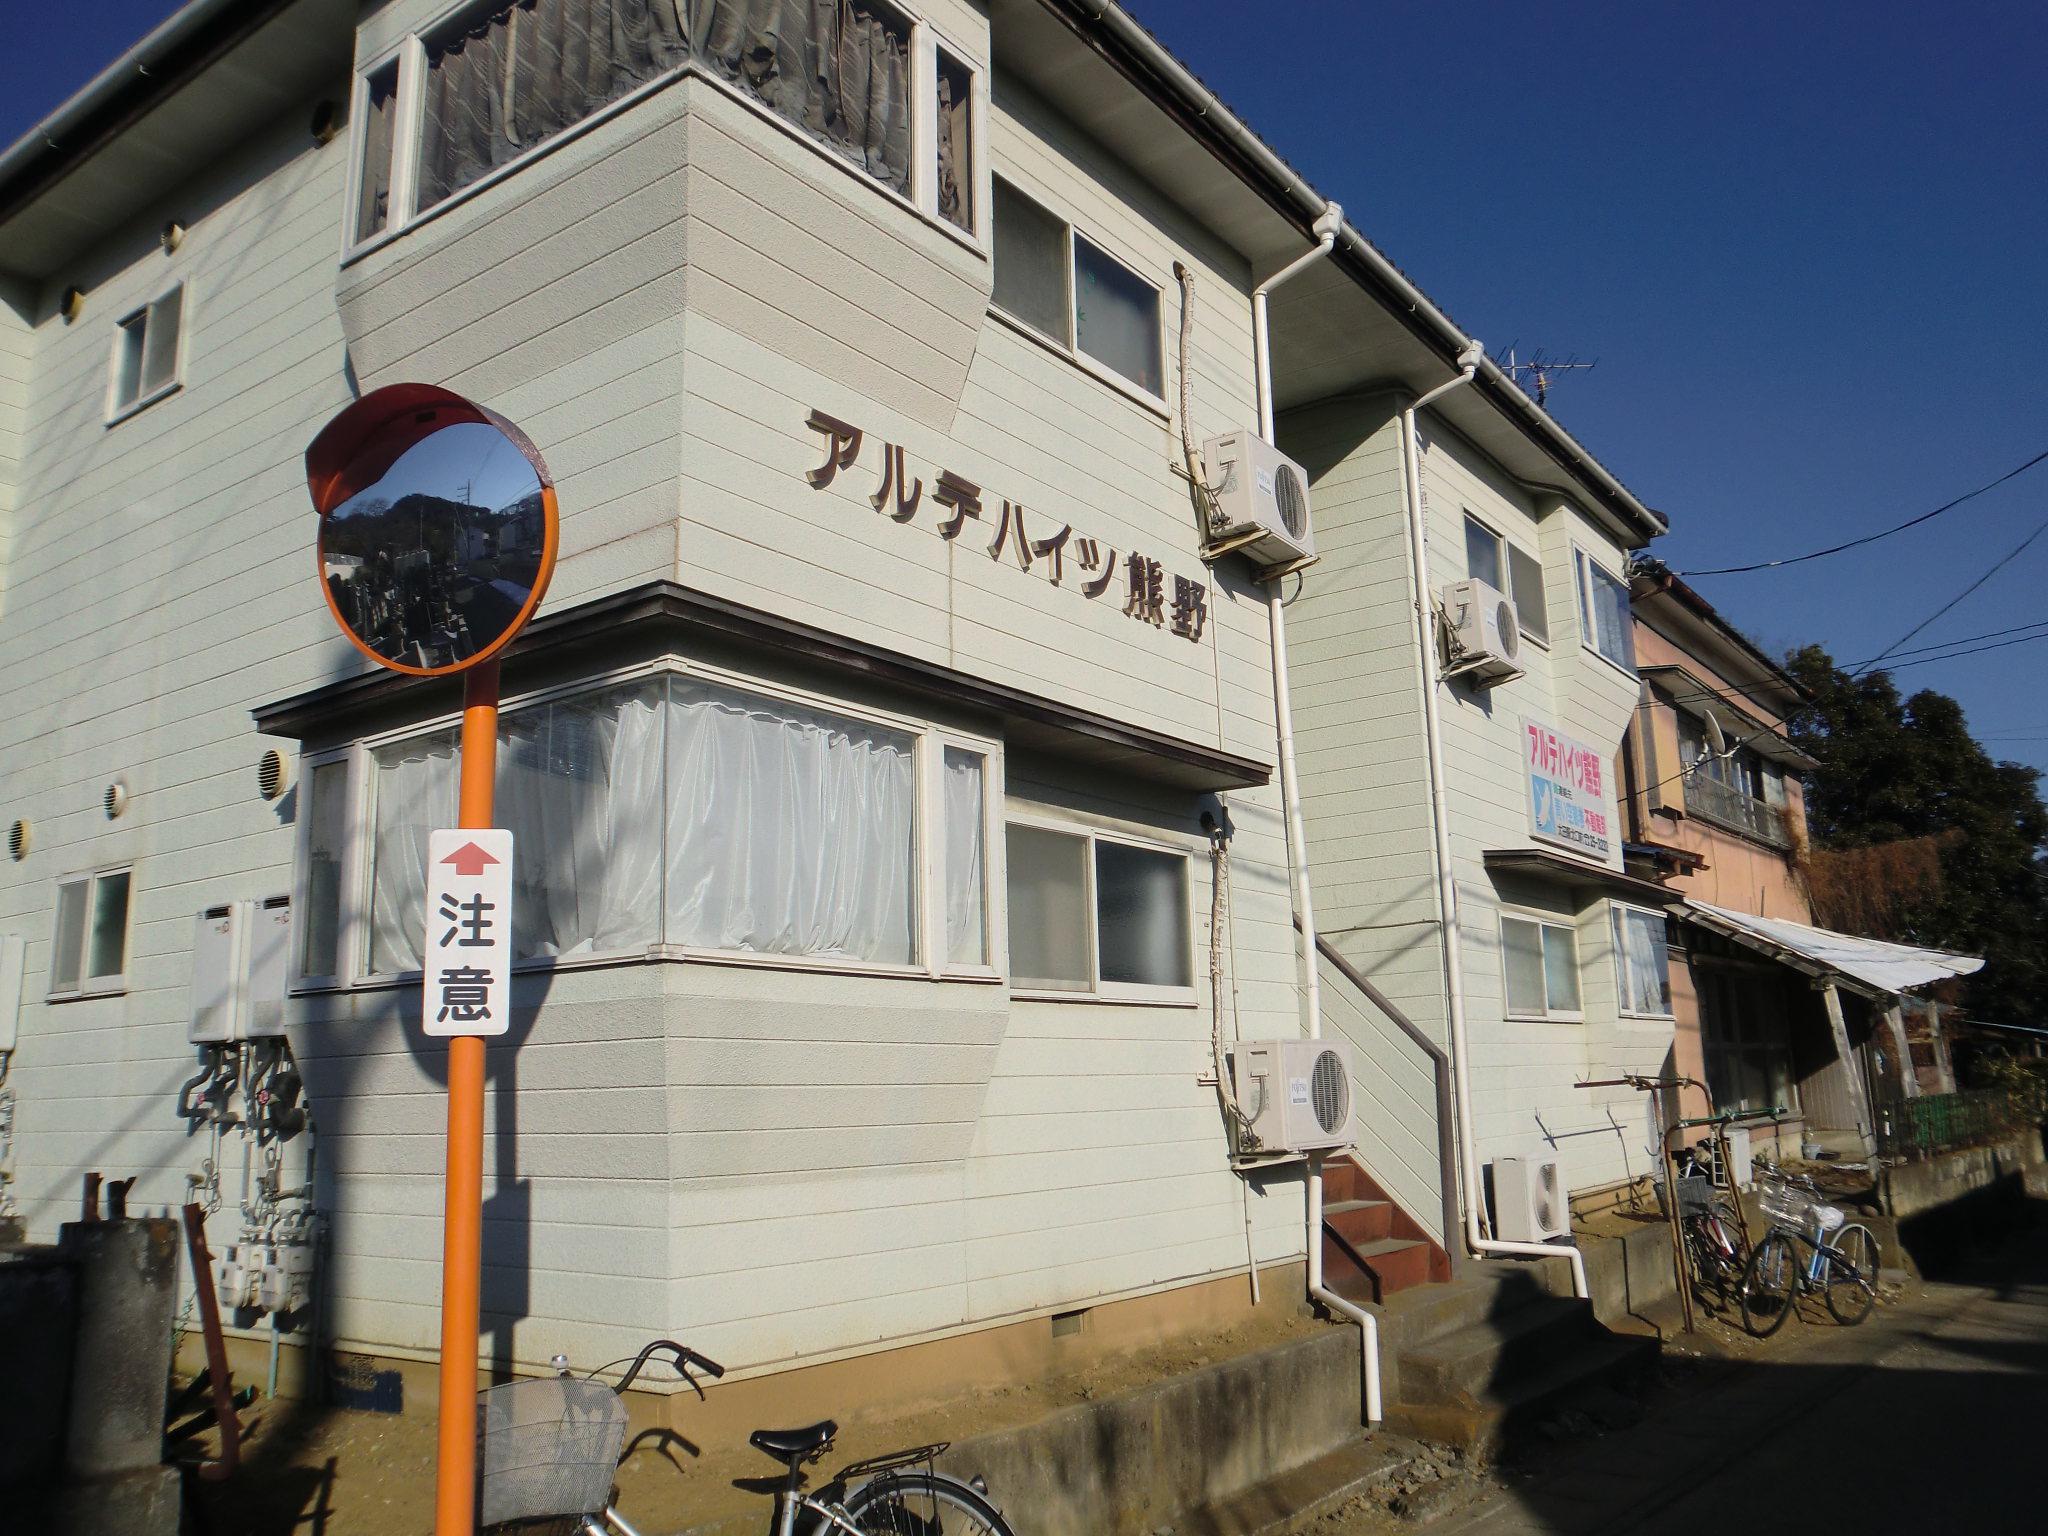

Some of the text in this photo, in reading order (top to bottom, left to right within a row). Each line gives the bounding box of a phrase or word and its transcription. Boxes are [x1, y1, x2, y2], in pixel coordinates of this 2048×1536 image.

[804, 408, 1208, 643] アルテハイツ熊野
[436, 892, 496, 1023] 注意
